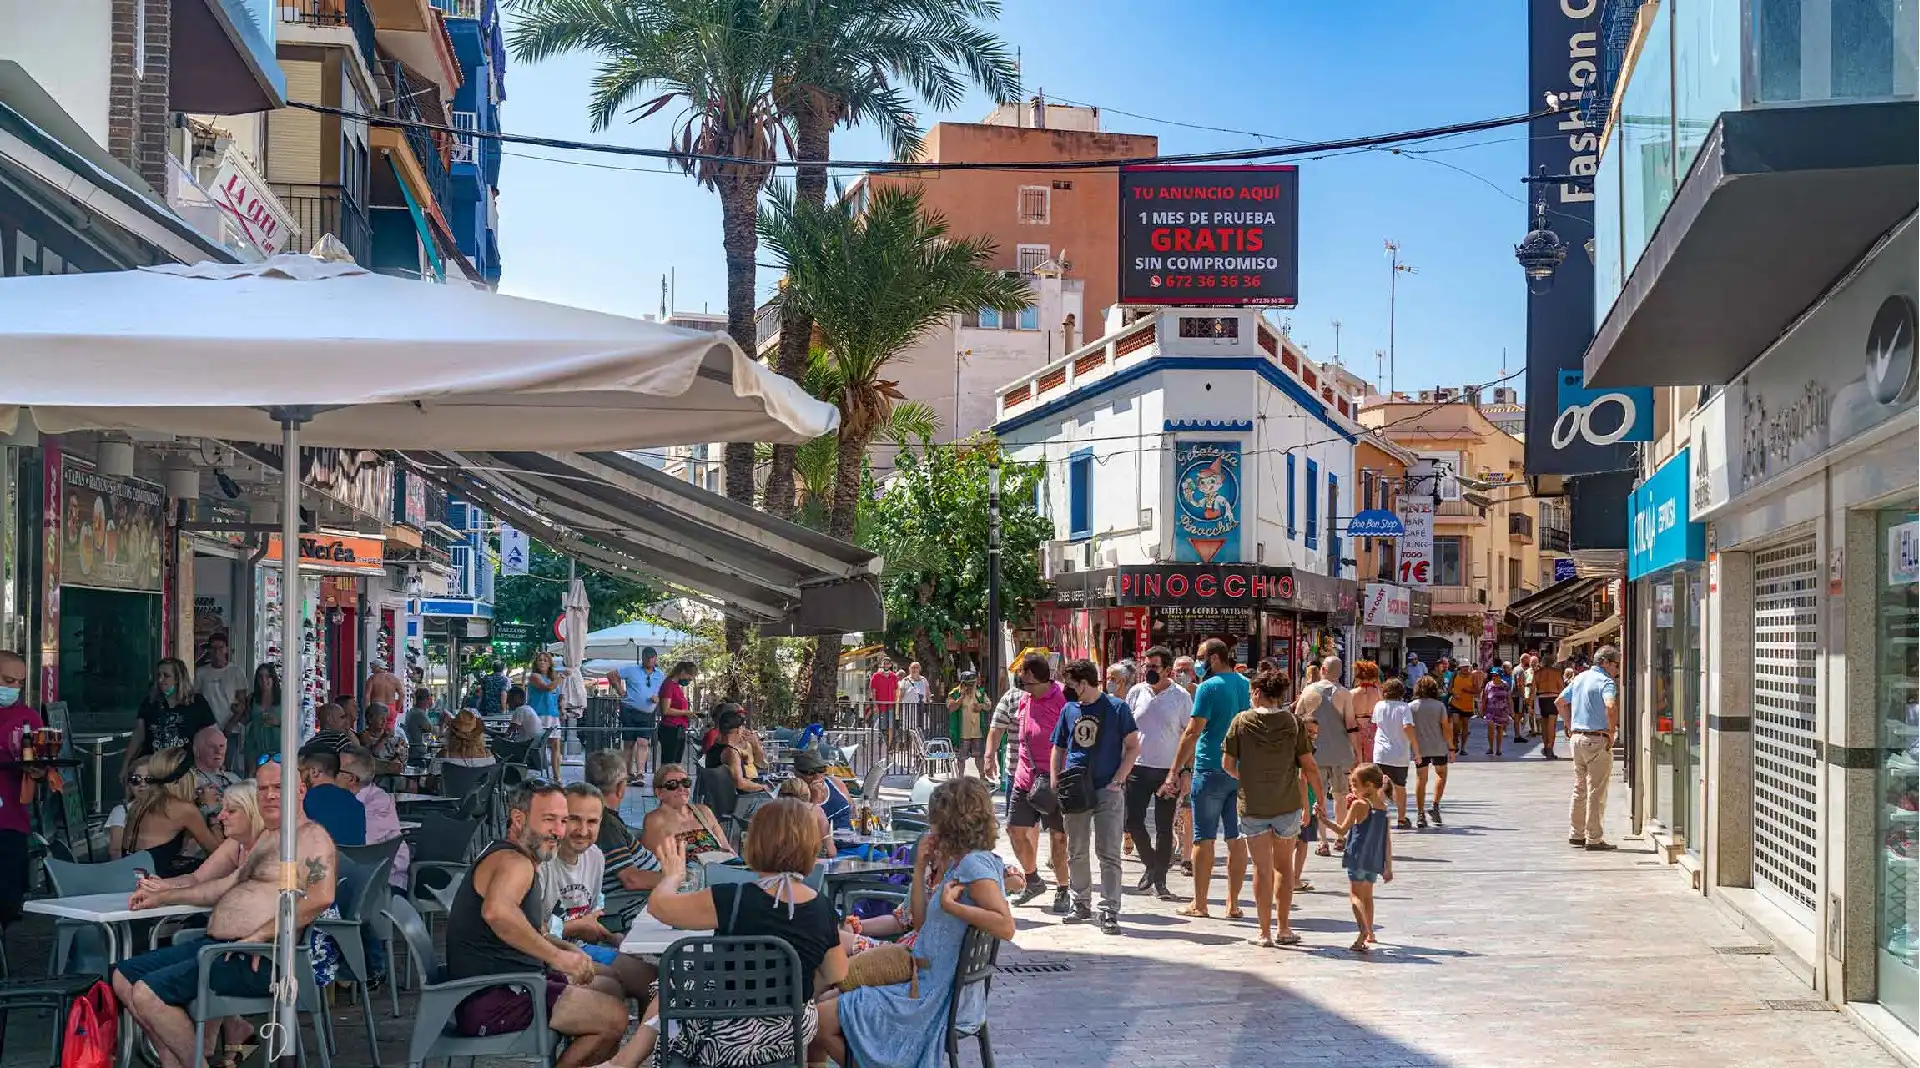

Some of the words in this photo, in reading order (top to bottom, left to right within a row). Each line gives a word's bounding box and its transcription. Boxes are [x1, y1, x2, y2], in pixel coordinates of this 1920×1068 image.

[1559, 32, 1597, 204] Fashion
[226, 174, 246, 206] LA
[1133, 186, 1154, 199] TU
[1158, 186, 1235, 200] ANUNCIO
[1239, 184, 1280, 202] AQUÍ
[1139, 212, 1147, 225] 1
[1152, 212, 1185, 225] MES
[1190, 212, 1210, 225] DE
[1214, 212, 1276, 225] PRUEBA
[1150, 227, 1264, 252] GRATIS
[1135, 257, 1162, 270] SIN
[1166, 256, 1278, 270] COMPROMISO
[1165, 275, 1192, 288] 672
[1197, 275, 1216, 288] 36
[1220, 275, 1238, 288] 36
[1243, 275, 1261, 288] 36
[1351, 519, 1365, 529] Bon
[1366, 519, 1380, 529] Bon
[1380, 519, 1399, 531] Shop
[1403, 528, 1426, 538] CAFÉ
[1401, 551, 1423, 559] TODO
[1400, 560, 1431, 583] 1€
[1120, 573, 1294, 598] PINOCCHIO
